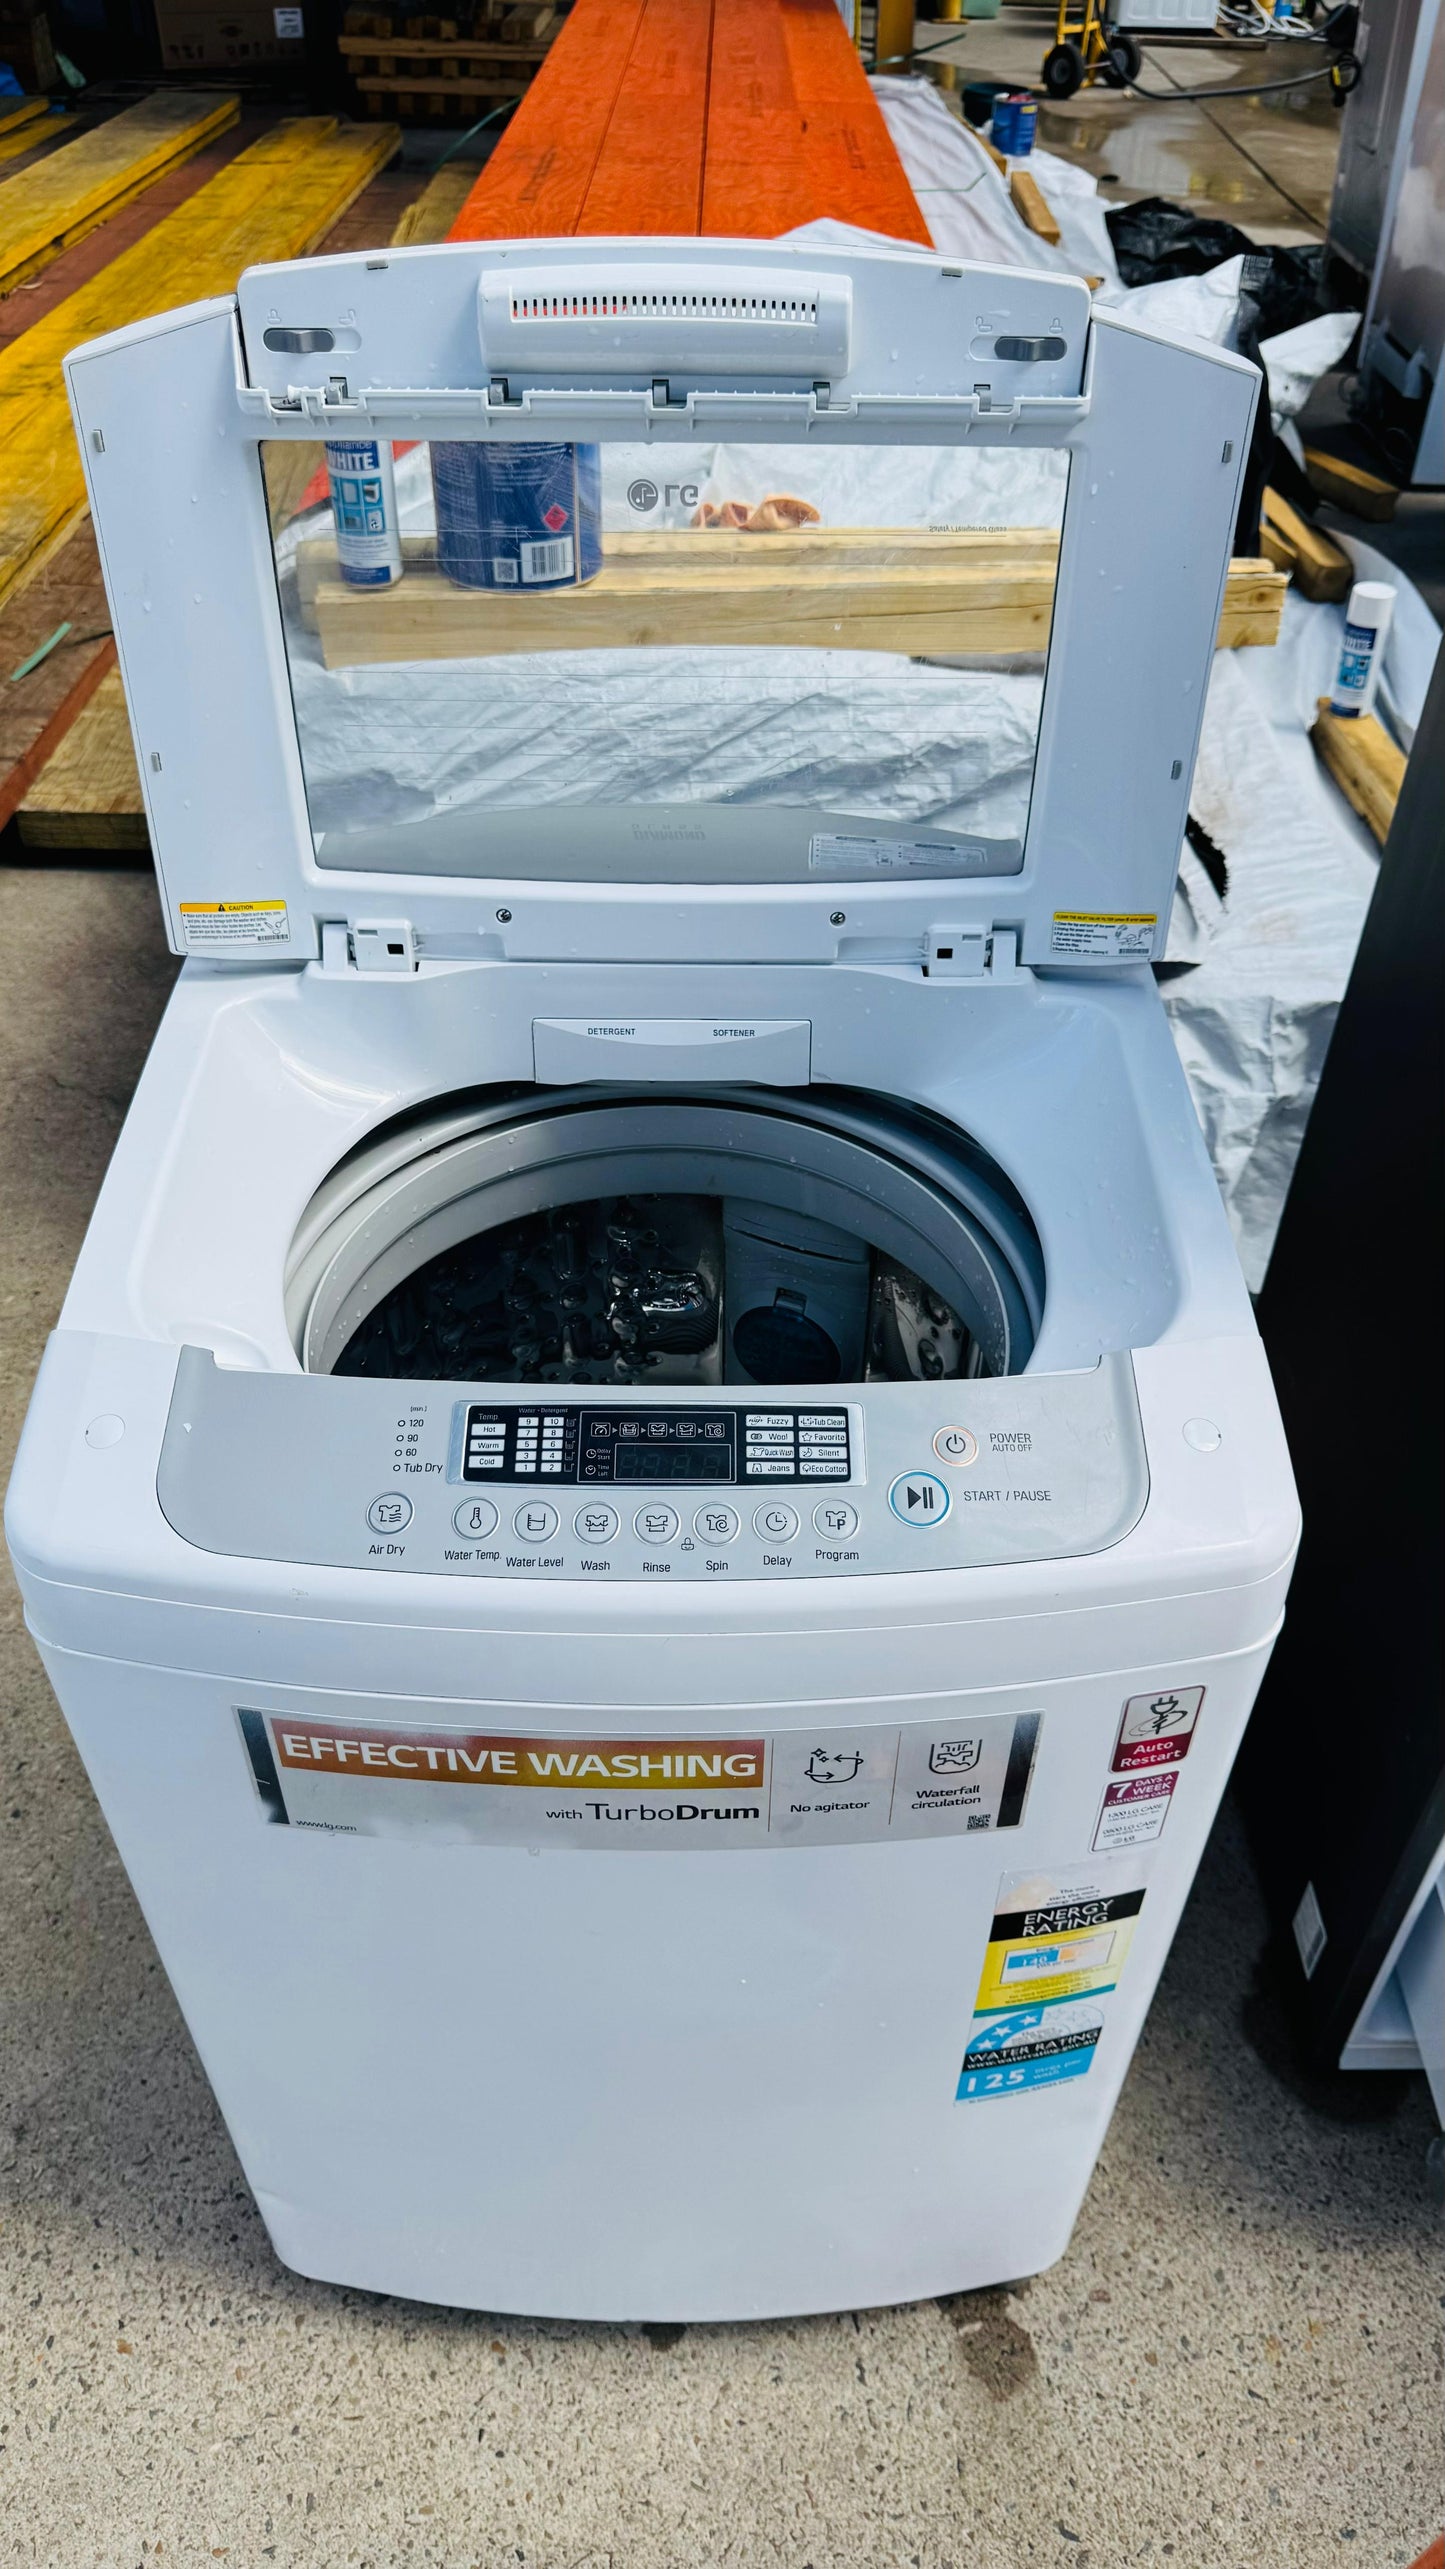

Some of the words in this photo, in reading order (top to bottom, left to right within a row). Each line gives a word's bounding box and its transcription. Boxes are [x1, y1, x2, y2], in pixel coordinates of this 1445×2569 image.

[327, 448, 374, 470] WHITE
[587, 1027, 636, 1036] DETERGENT
[712, 1029, 755, 1037] SOFTENER
[767, 1417, 789, 1425] Fuzzy
[407, 1434, 419, 1442] 90
[989, 1433, 1032, 1443] POWER
[406, 1448, 417, 1456] 60
[992, 1443, 1016, 1452] AUTO
[1018, 1444, 1033, 1452] OFF
[404, 1463, 422, 1472] Tub
[425, 1463, 443, 1474] Dry
[963, 1490, 1001, 1501] START
[1005, 1490, 1010, 1501] /
[1013, 1490, 1052, 1501] PAUSE
[368, 1545, 384, 1555] Air
[386, 1545, 406, 1556] Dry
[444, 1550, 472, 1560] Water
[475, 1550, 502, 1562] Temp.
[815, 1549, 860, 1562] Program
[506, 1557, 536, 1568] Water
[538, 1557, 564, 1568] Level
[581, 1561, 610, 1571] Wash
[642, 1562, 671, 1573] Rinse
[706, 1560, 728, 1573] Spin
[763, 1555, 792, 1568] Delay
[1133, 1741, 1174, 1755] Auto
[282, 1733, 518, 1775] EFFECTIVE
[527, 1752, 757, 1778] WASHING
[1120, 1750, 1181, 1768] Restart
[916, 1784, 980, 1799] Waterfall
[1112, 1782, 1132, 1798] 7
[1135, 1776, 1163, 1787] DAYS
[1132, 1781, 1172, 1795] WEEK
[911, 1796, 982, 1810] circulation
[1108, 1794, 1150, 1806] CUSTOMER
[546, 1809, 582, 1820] with
[585, 1802, 759, 1821] TurboDrum
[790, 1804, 811, 1812] No
[814, 1801, 870, 1813] agitator
[296, 1820, 357, 1832] www.lg.com
[1024, 1899, 1114, 1925] ENERGY
[1022, 1912, 1108, 1937] RATING
[968, 2045, 1030, 2062] WATER
[1035, 2030, 1099, 2051] RATING
